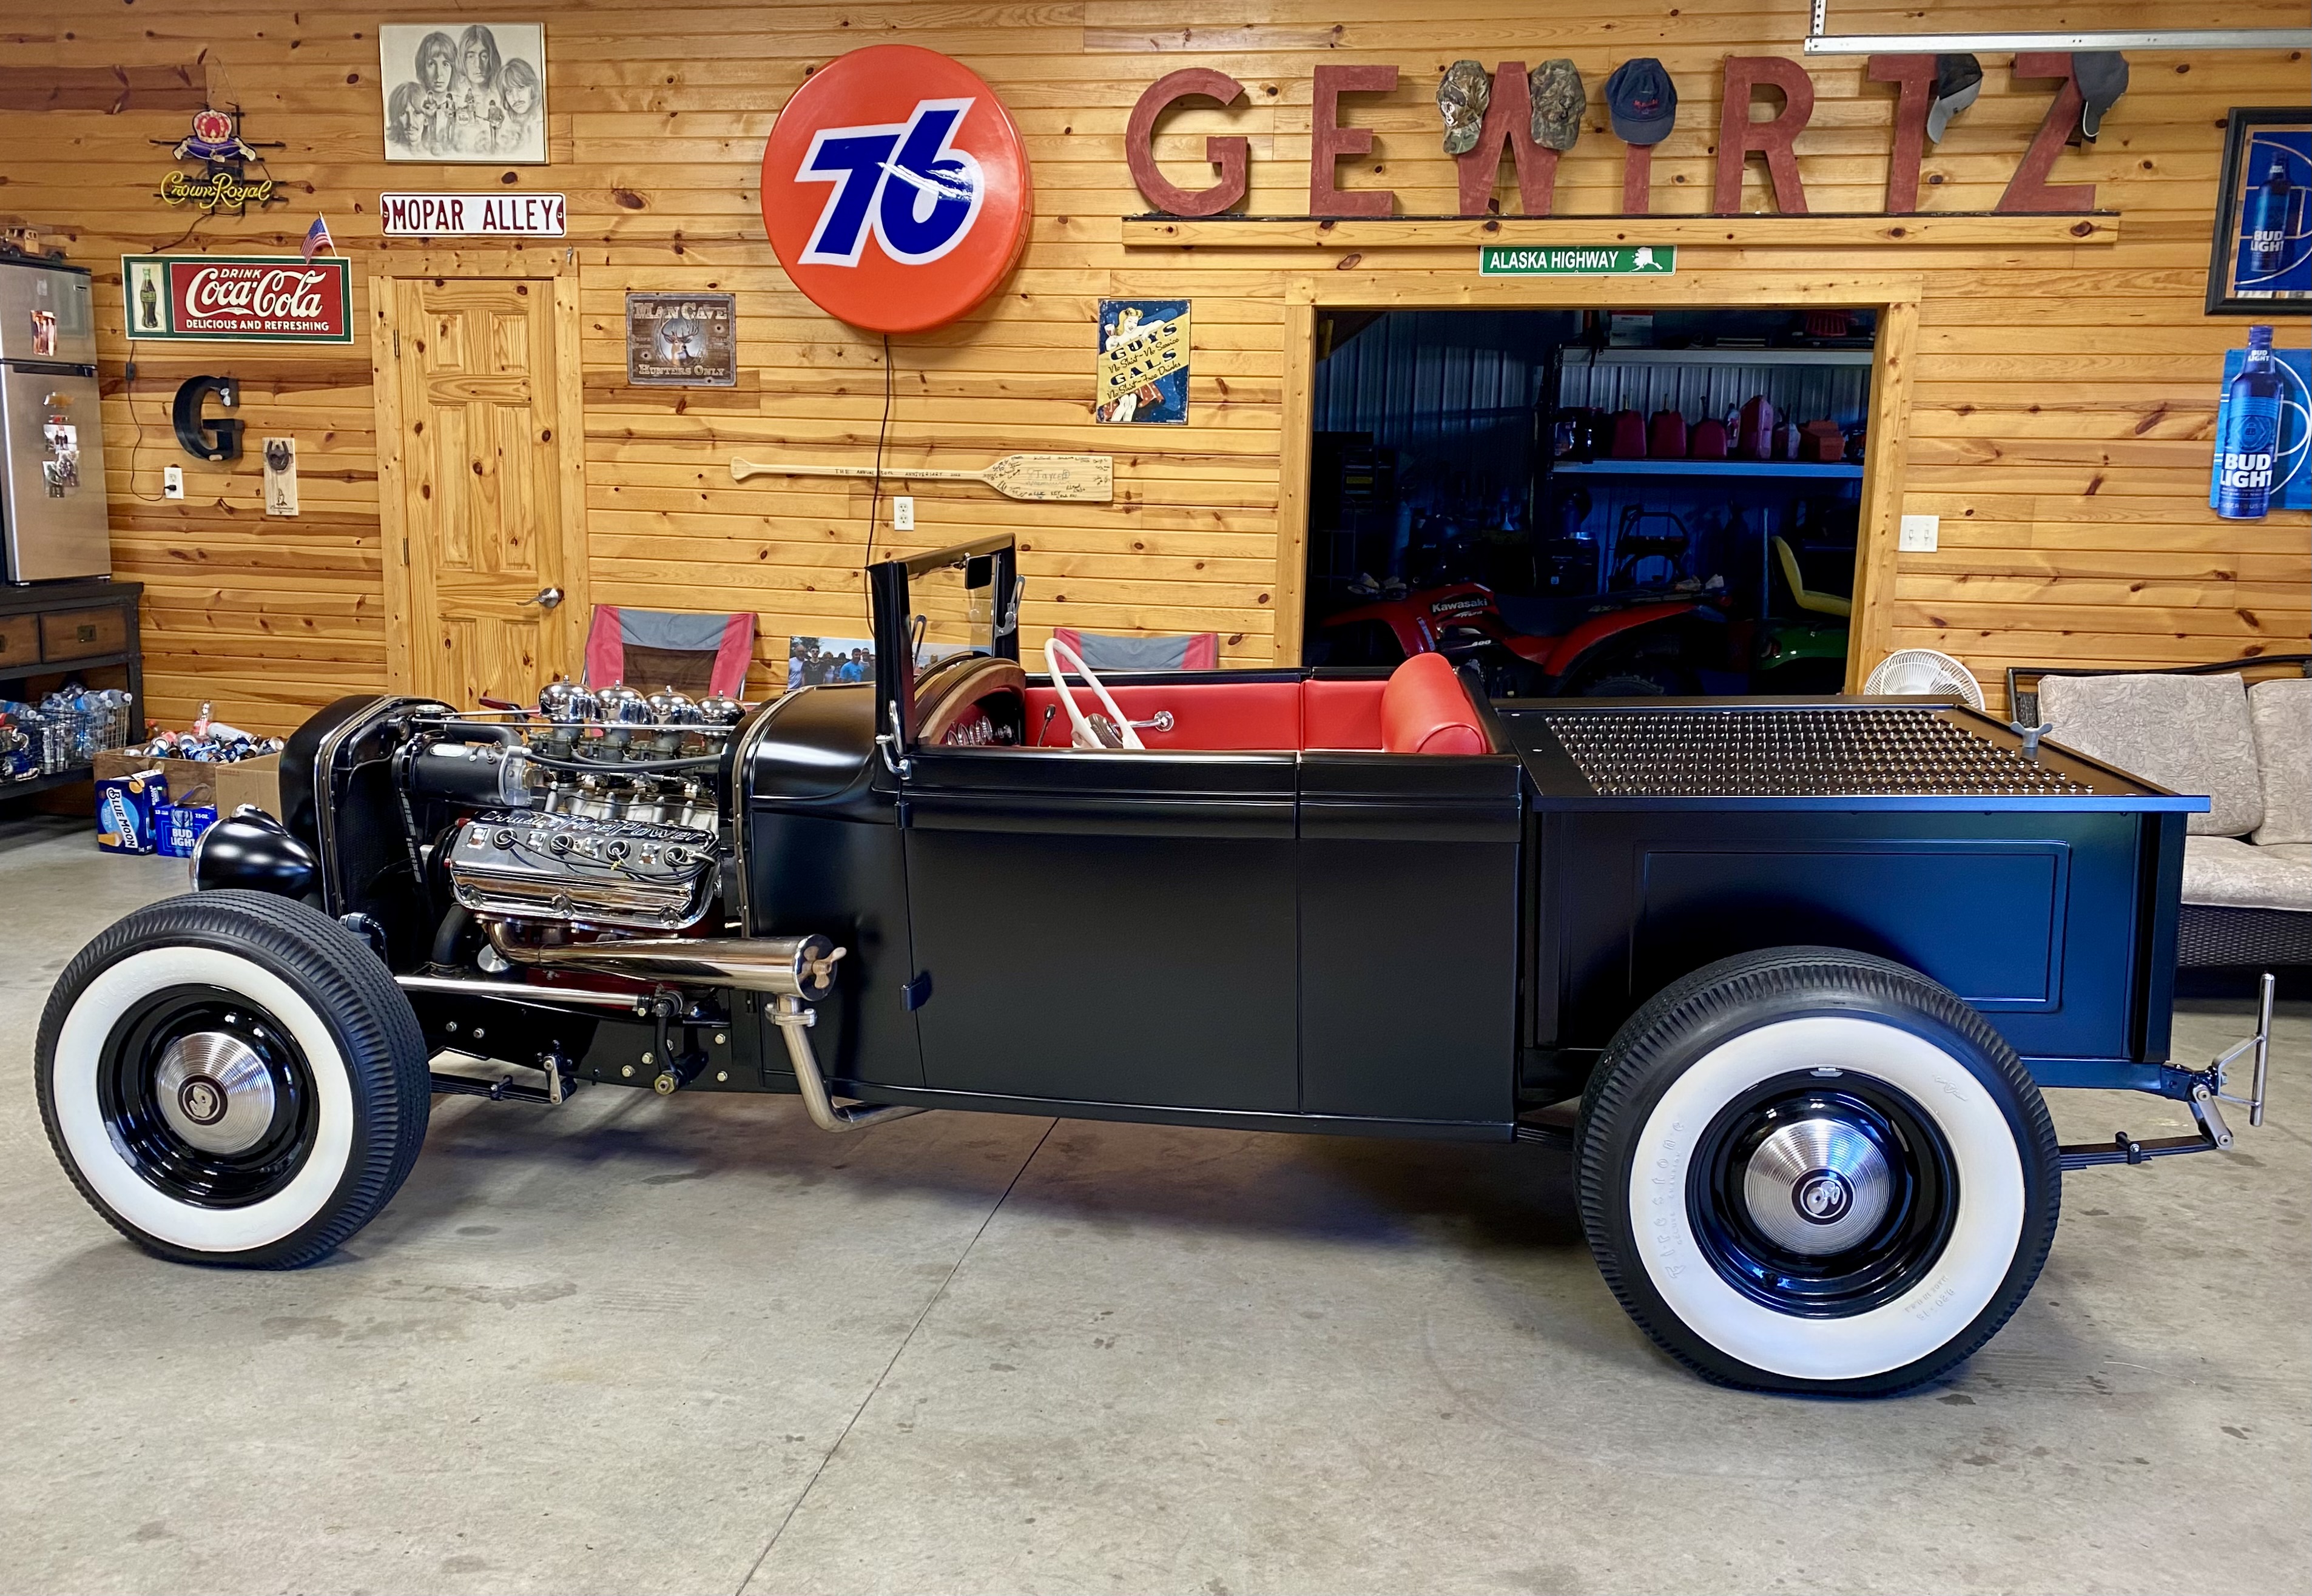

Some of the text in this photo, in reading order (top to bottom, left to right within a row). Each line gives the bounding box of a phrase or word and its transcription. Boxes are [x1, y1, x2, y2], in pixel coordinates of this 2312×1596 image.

[161, 170, 272, 209] Crown Royal
[794, 96, 985, 268] 76
[393, 200, 553, 231] MOPAR ALLEY
[2251, 241, 2284, 252] LIGHT
[2254, 231, 2283, 241] BUD
[1490, 251, 1619, 269] ALASKA HIGHWAY
[220, 269, 262, 278] DRINK
[185, 268, 327, 318] Coca-Cola
[186, 318, 329, 331] DELICIOUS AND REFRESHING
[1110, 323, 1177, 360] GUYS
[1108, 337, 1180, 374] No Shirt No Service
[1110, 348, 1177, 386] GALS
[1107, 389, 1119, 399] No
[1118, 380, 1136, 395] Shirt
[1158, 361, 1181, 375] Drinks
[173, 375, 246, 461] G
[2225, 454, 2271, 471] BUD
[2220, 470, 2273, 488] LIGHT
[1432, 598, 1488, 613] Kawasaki
[107, 789, 135, 847] BLUE MOON
[170, 837, 195, 847] LIGHT
[172, 828, 193, 838] BUD
